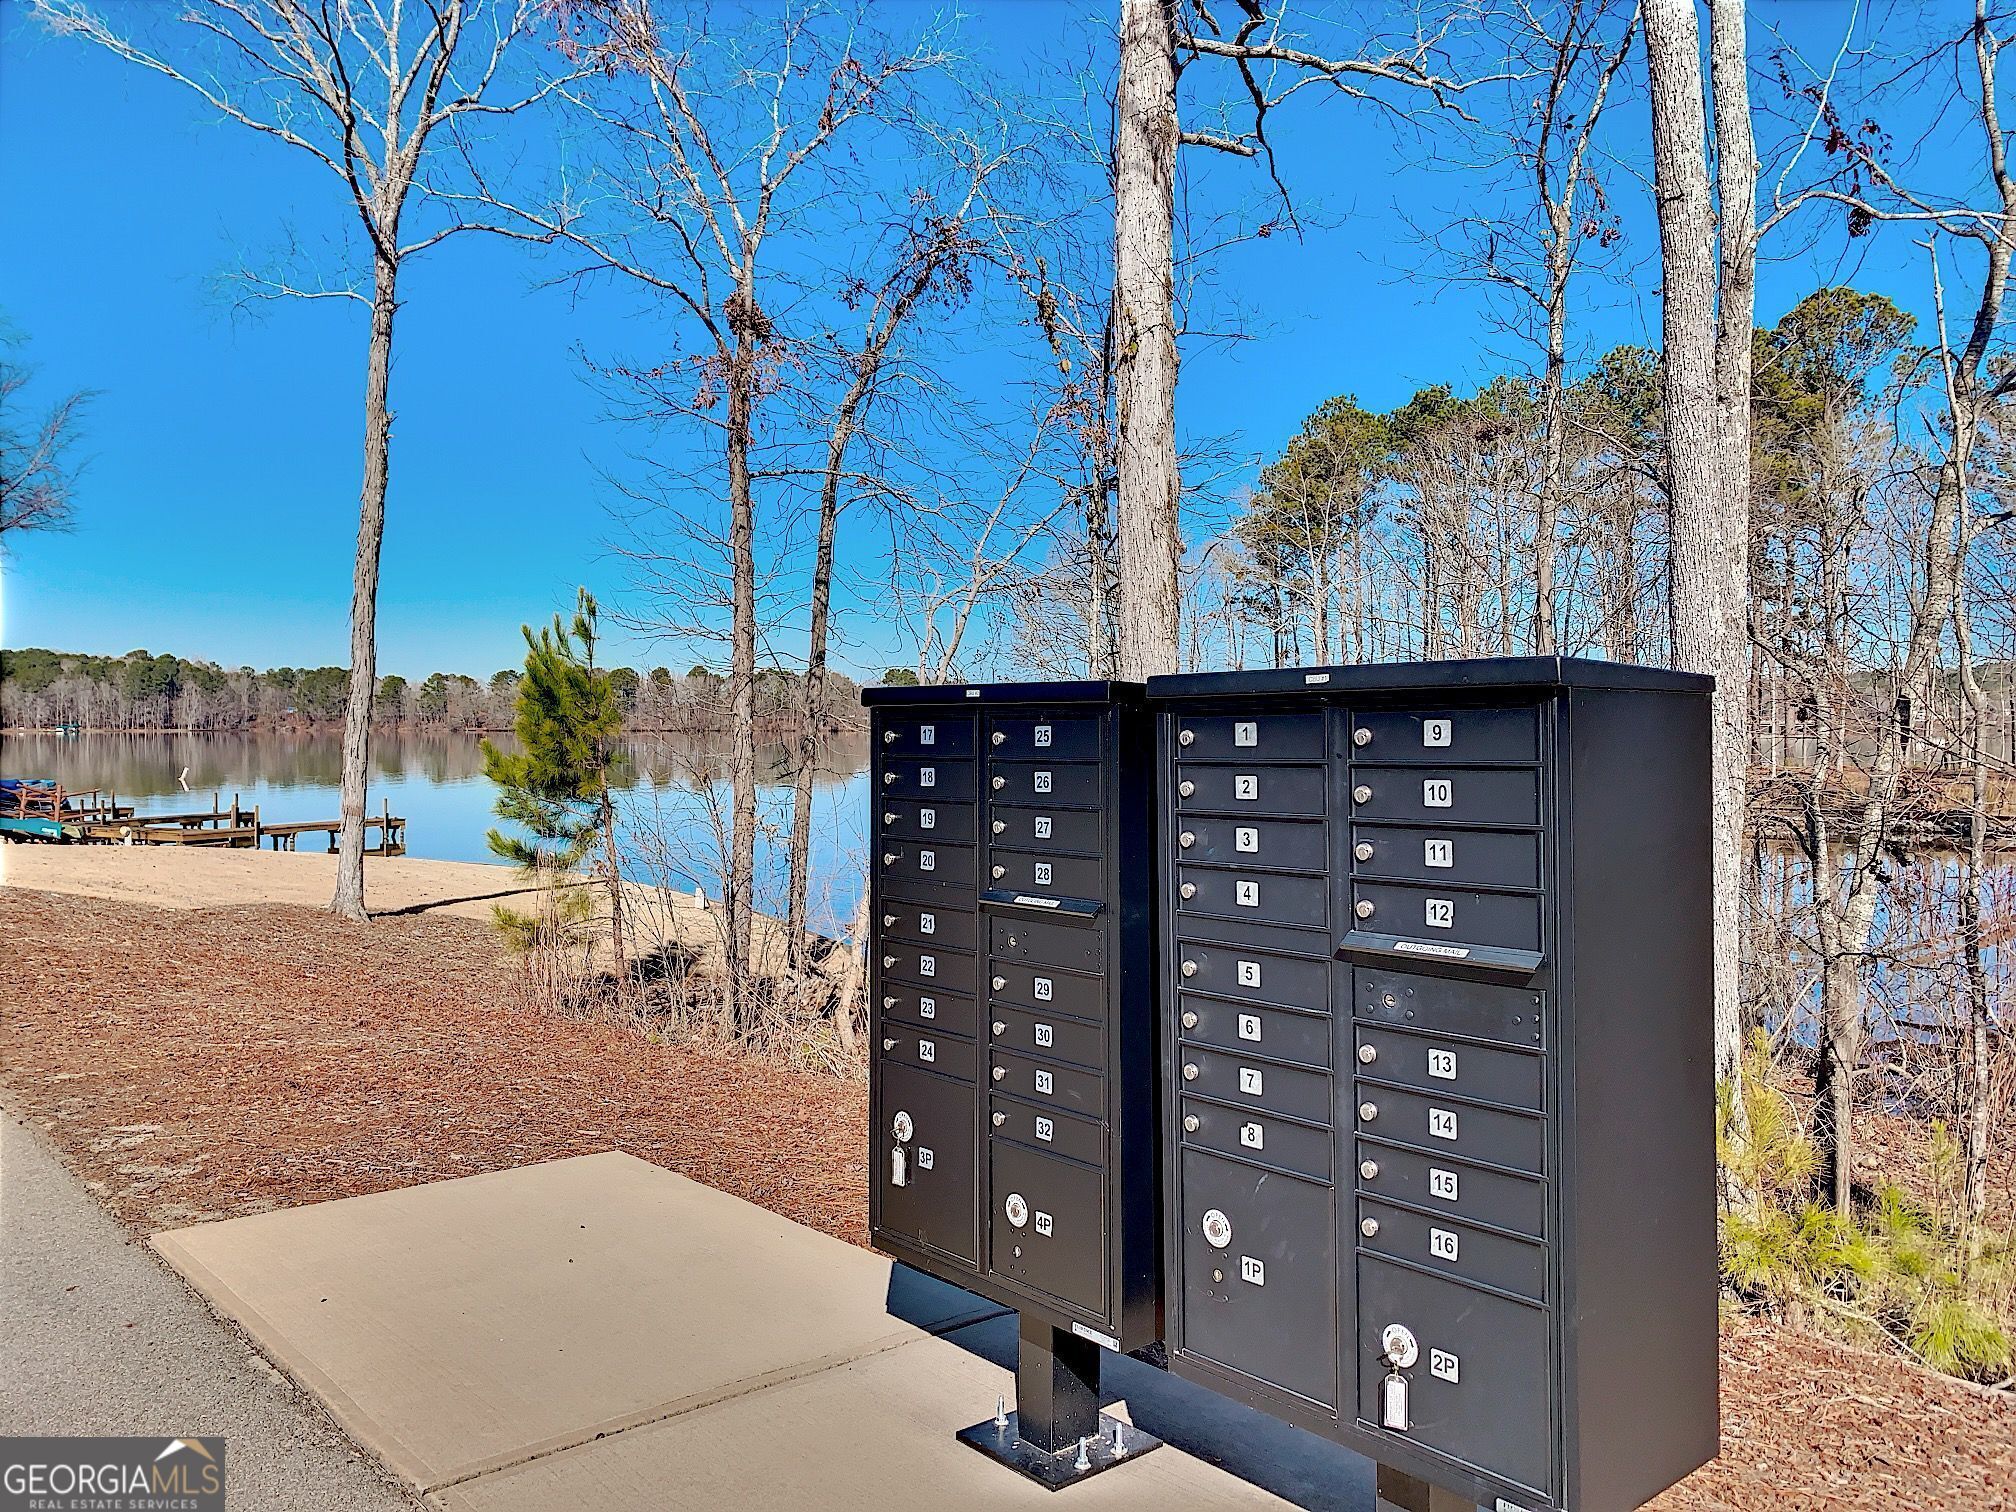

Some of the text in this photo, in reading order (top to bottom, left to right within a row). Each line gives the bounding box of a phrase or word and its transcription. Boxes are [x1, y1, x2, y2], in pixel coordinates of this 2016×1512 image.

[921, 727, 933, 742] 17
[1036, 727, 1049, 742] 25
[1243, 726, 1251, 742] 1
[1431, 723, 1443, 741] 9
[922, 768, 934, 783] 18
[1036, 772, 1050, 789] 26
[1242, 779, 1251, 795] 2
[1428, 784, 1448, 802] 10
[922, 811, 934, 825] 19
[1036, 820, 1050, 835] 27
[1242, 831, 1251, 847] 3
[1429, 843, 1447, 861] 11
[922, 854, 934, 867] 20
[1036, 866, 1050, 881] 28
[1243, 885, 1252, 901] 4
[1430, 903, 1450, 922] 12
[922, 917, 933, 930] 21
[1400, 943, 1462, 956] OUTGOING MAIL
[921, 959, 933, 973] 22
[1245, 965, 1253, 981] 5
[1036, 981, 1050, 997] 29
[921, 1001, 934, 1015] 23
[1037, 1027, 1051, 1043] 30
[1245, 1019, 1254, 1035] 6
[921, 1044, 933, 1058] 24
[1432, 1053, 1452, 1073] 13
[1037, 1074, 1050, 1090] 31
[1246, 1072, 1255, 1088] 7
[1037, 1121, 1051, 1138] 32
[1433, 1113, 1453, 1133] 14
[1247, 1126, 1256, 1142] 8
[919, 1150, 932, 1165] 3P
[1434, 1174, 1454, 1194] 15
[1036, 1216, 1051, 1231] 4P
[1434, 1234, 1454, 1254] 16
[1243, 1260, 1262, 1279] 1P
[1432, 1353, 1456, 1374] 2P
